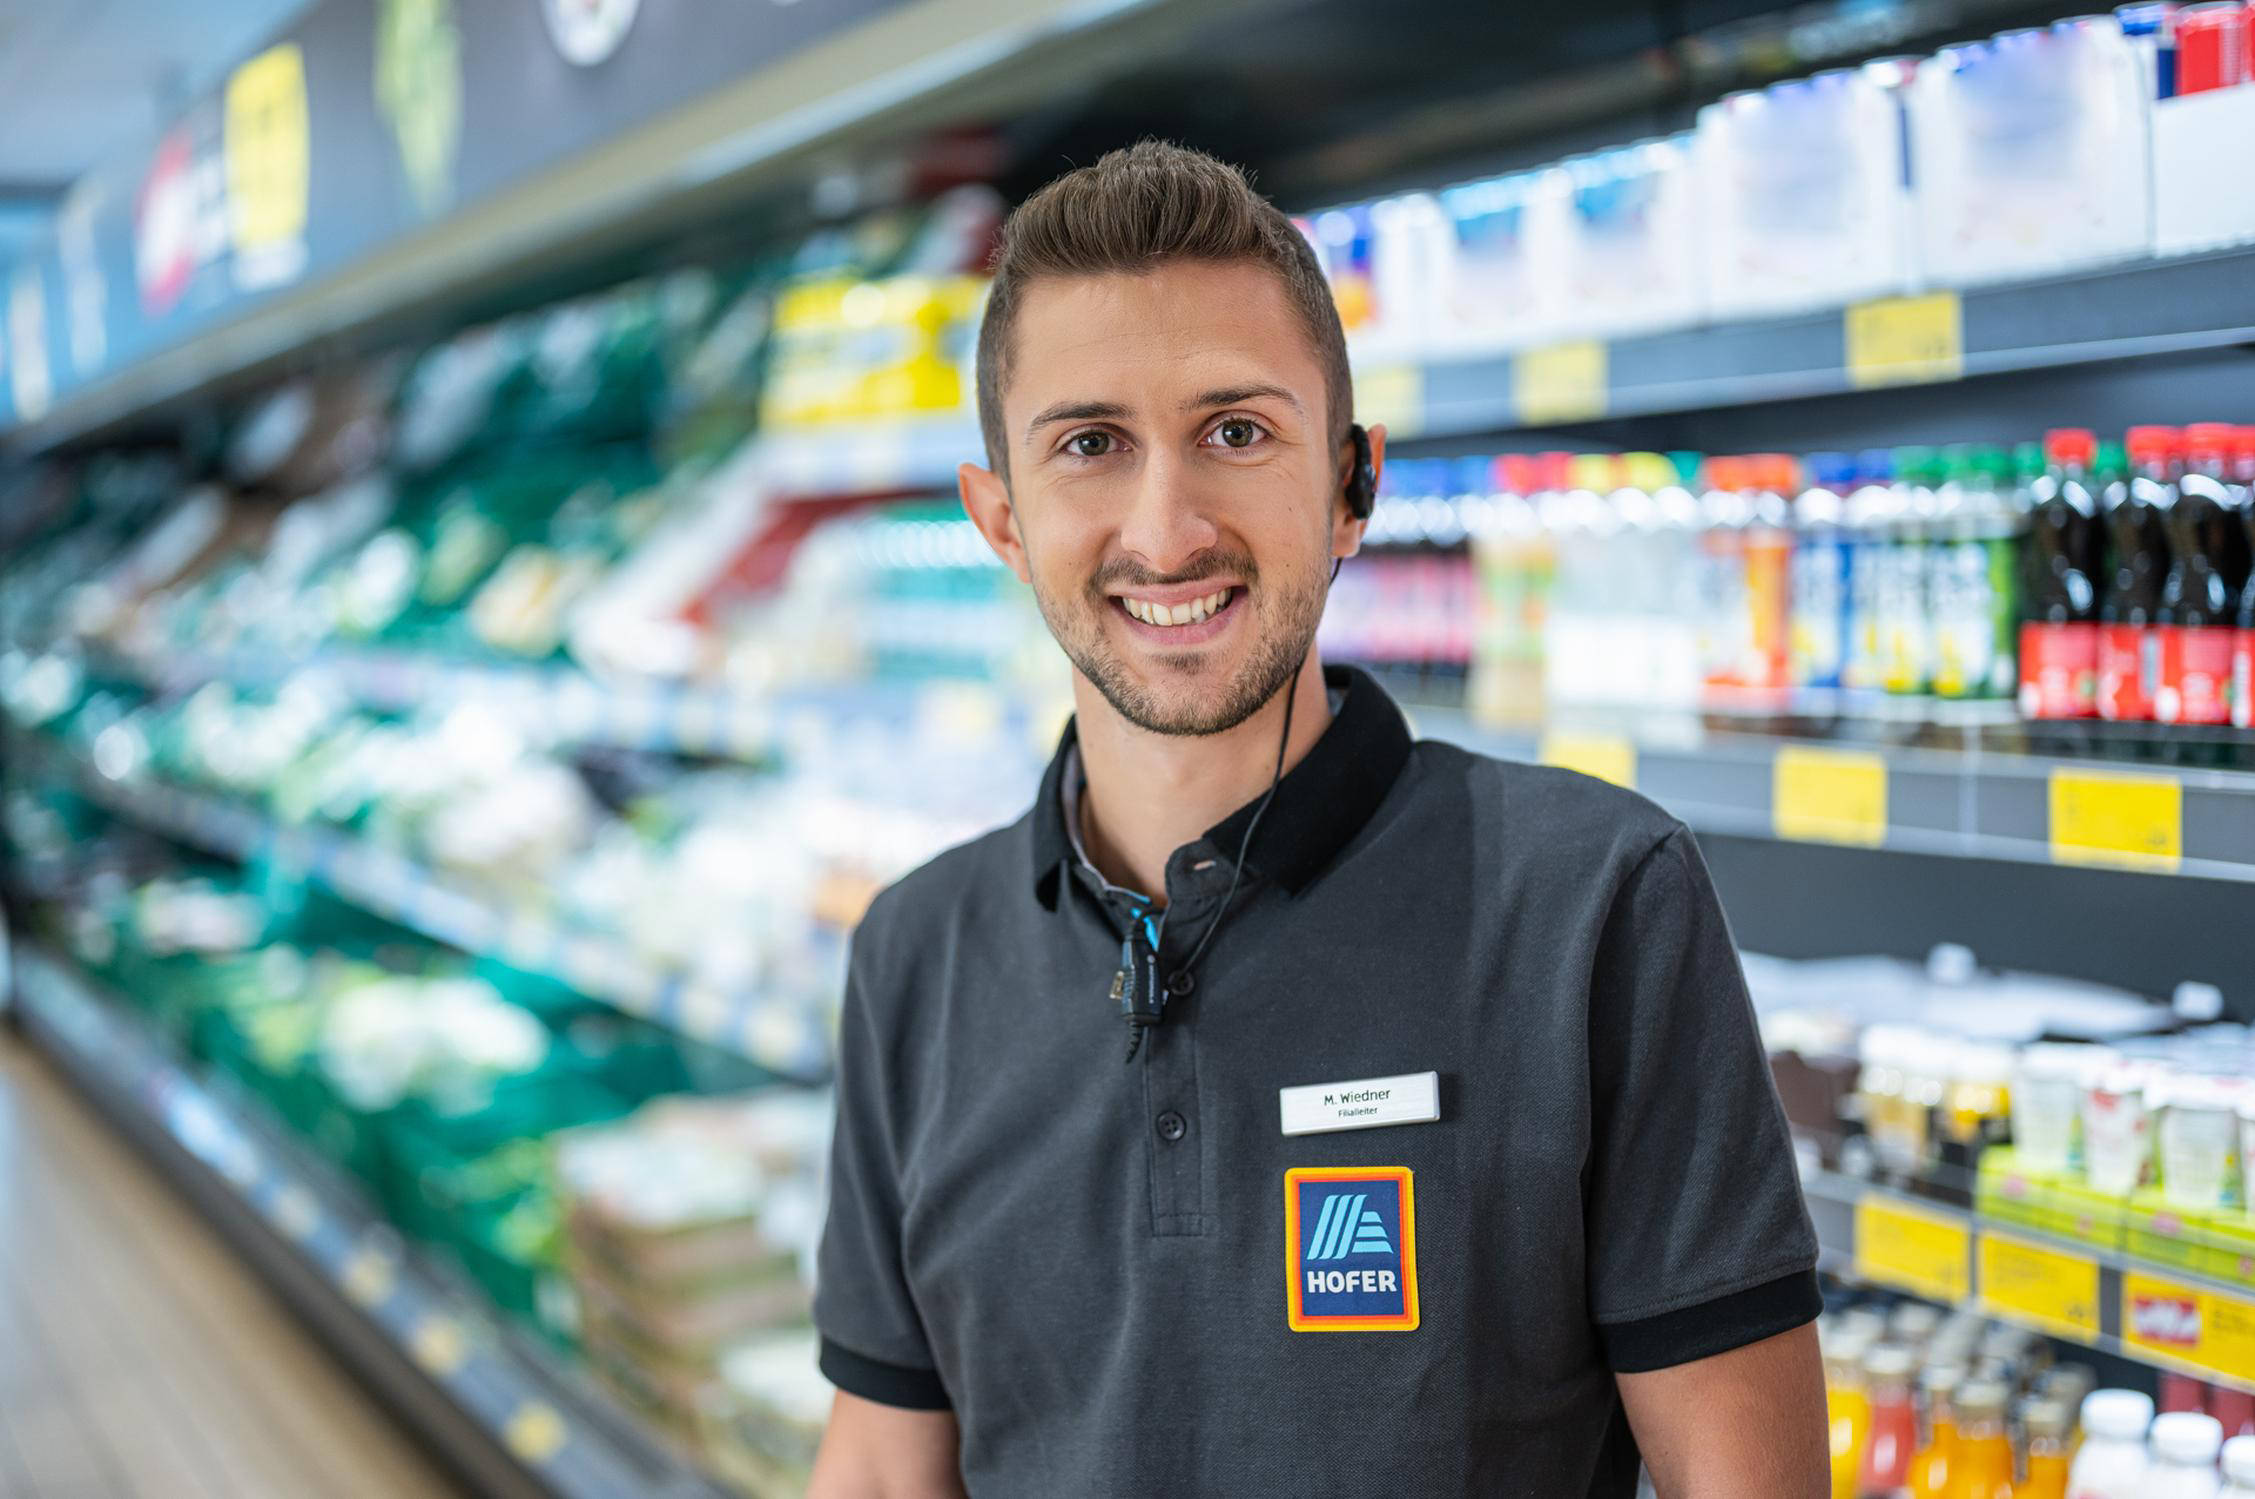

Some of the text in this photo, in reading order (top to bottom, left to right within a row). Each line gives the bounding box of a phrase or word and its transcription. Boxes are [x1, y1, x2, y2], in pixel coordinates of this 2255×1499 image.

[1324, 1089, 1390, 1106] M. Wiedner
[1307, 1270, 1397, 1293] HOFER
